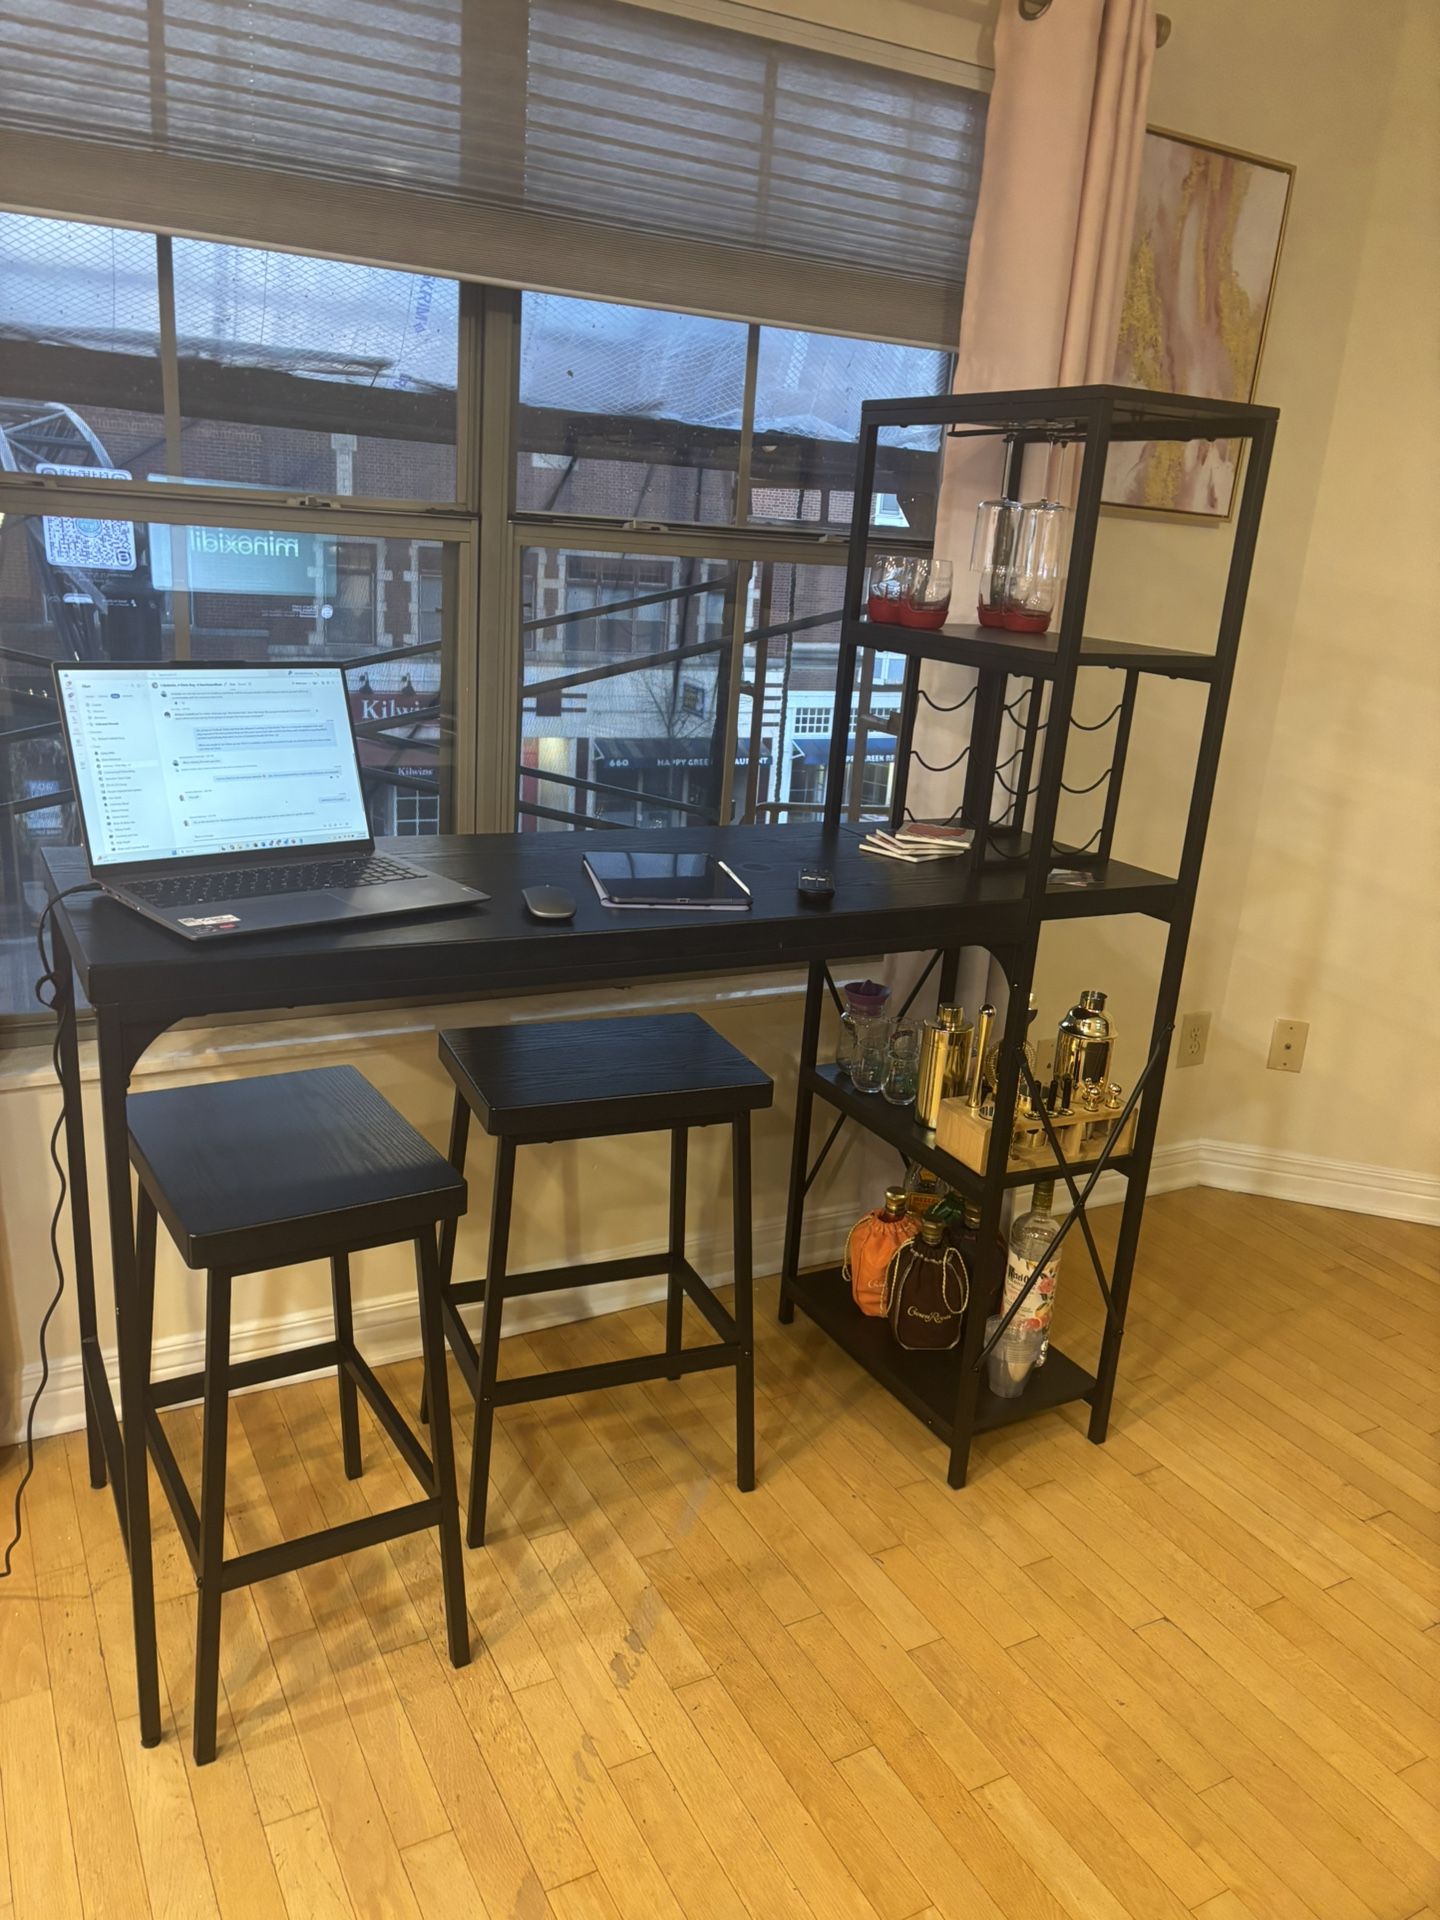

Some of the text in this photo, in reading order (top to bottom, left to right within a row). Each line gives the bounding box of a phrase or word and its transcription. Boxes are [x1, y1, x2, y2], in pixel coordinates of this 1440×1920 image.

[609, 759, 629, 768] 660
[688, 758, 713, 766] GREE
[397, 767, 433, 777] Kilwins
